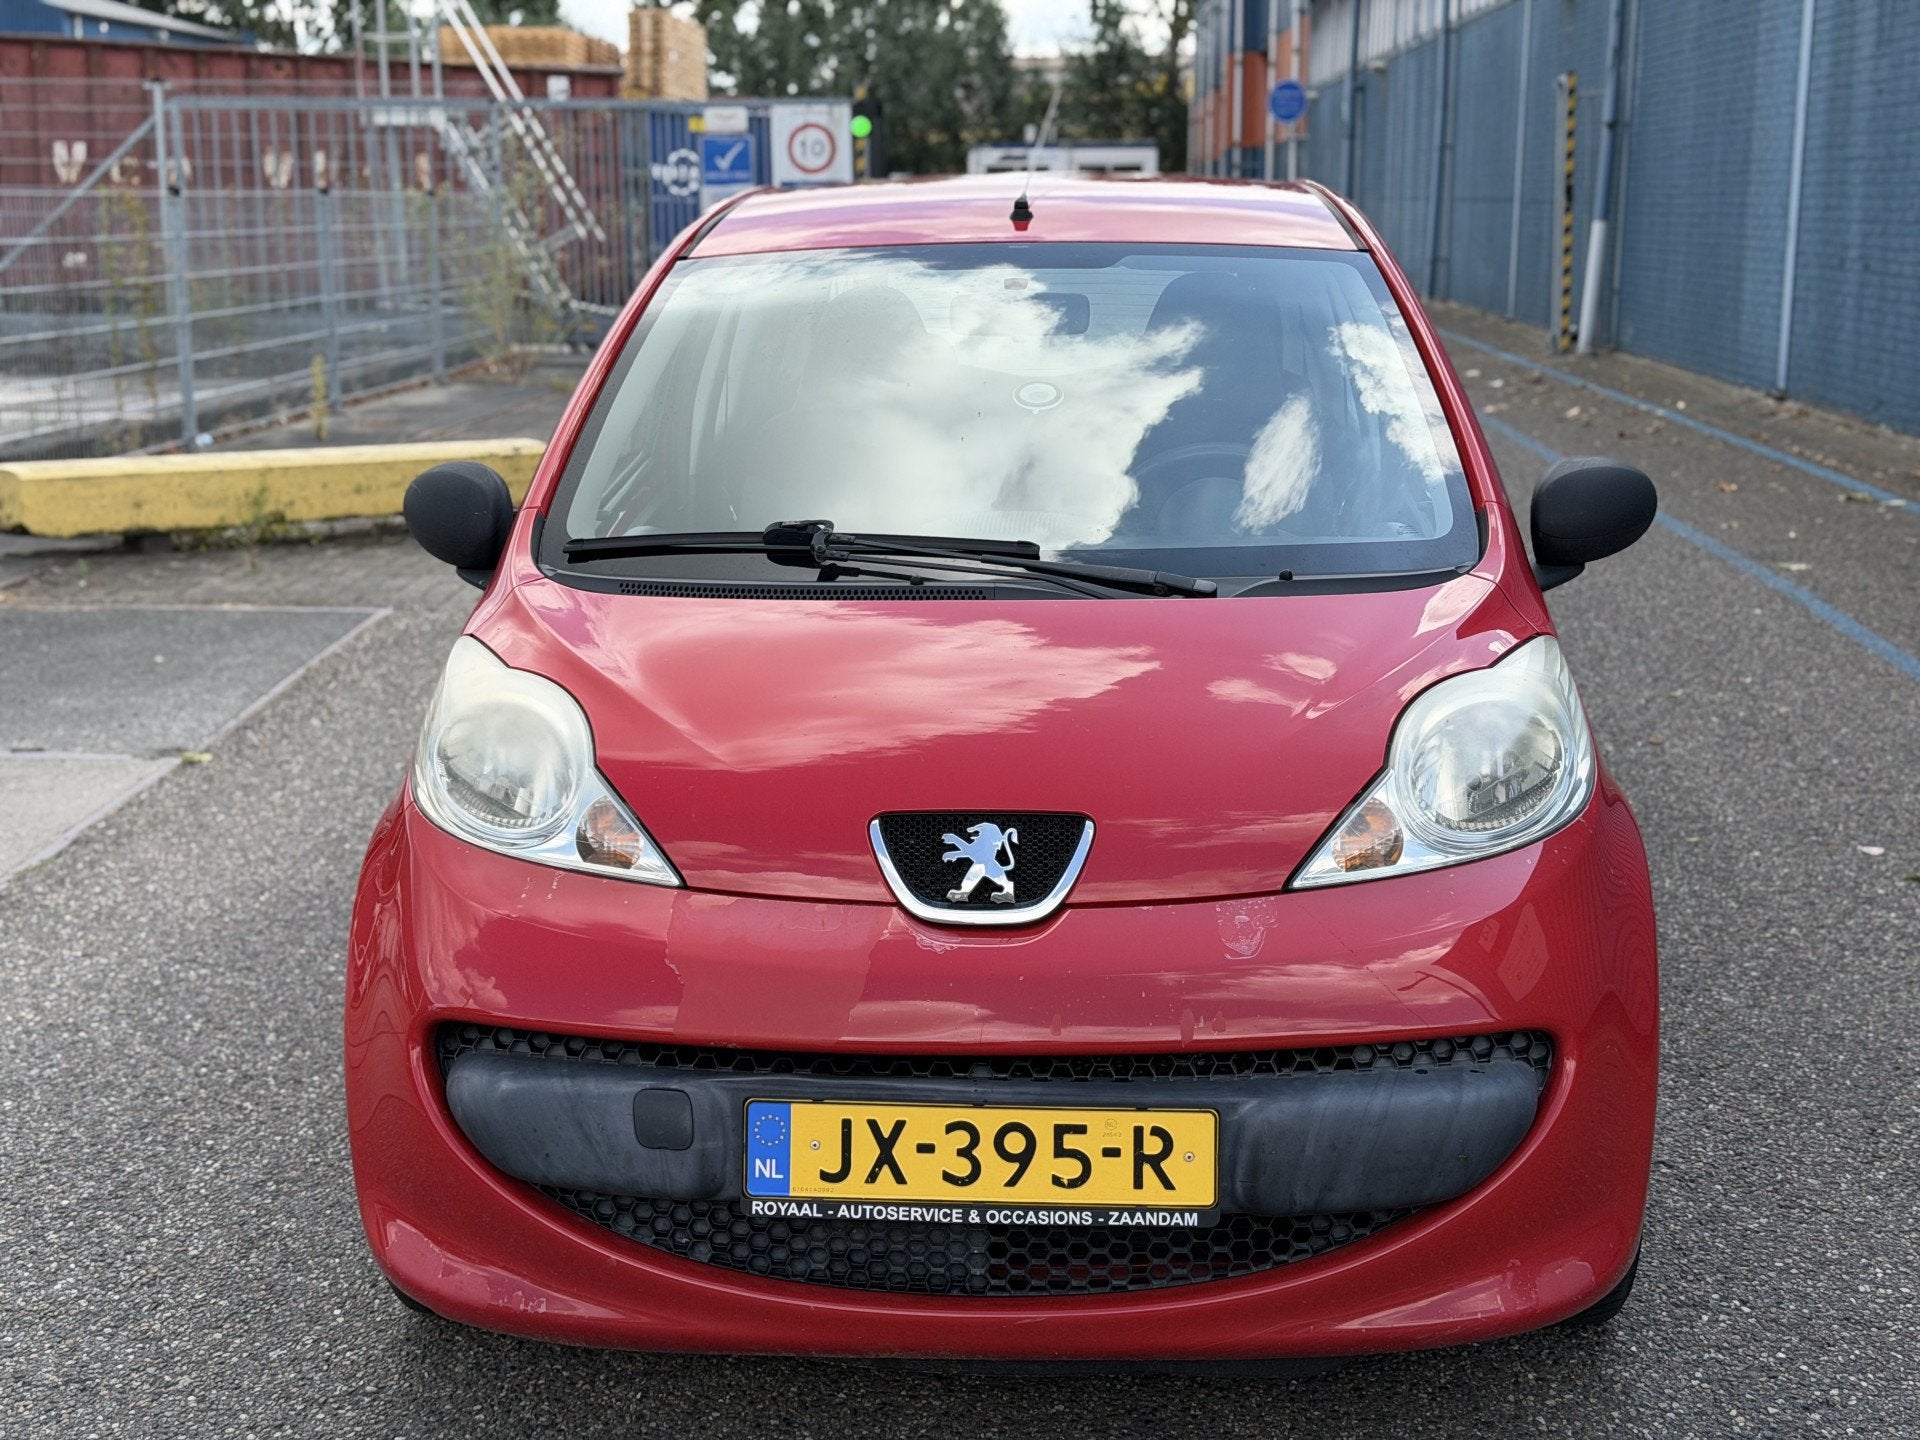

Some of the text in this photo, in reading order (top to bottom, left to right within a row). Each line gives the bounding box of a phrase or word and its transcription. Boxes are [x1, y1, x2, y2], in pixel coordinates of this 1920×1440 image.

[819, 1118, 1176, 1191] JX-395-R
[755, 1158, 784, 1179] NL
[751, 1201, 823, 1218] ROYAAL
[837, 1205, 963, 1224] AUTOSERVICE
[968, 1209, 981, 1224] &
[985, 1209, 1093, 1226] OCCASIONS
[1108, 1211, 1199, 1227] ZAANDAM
